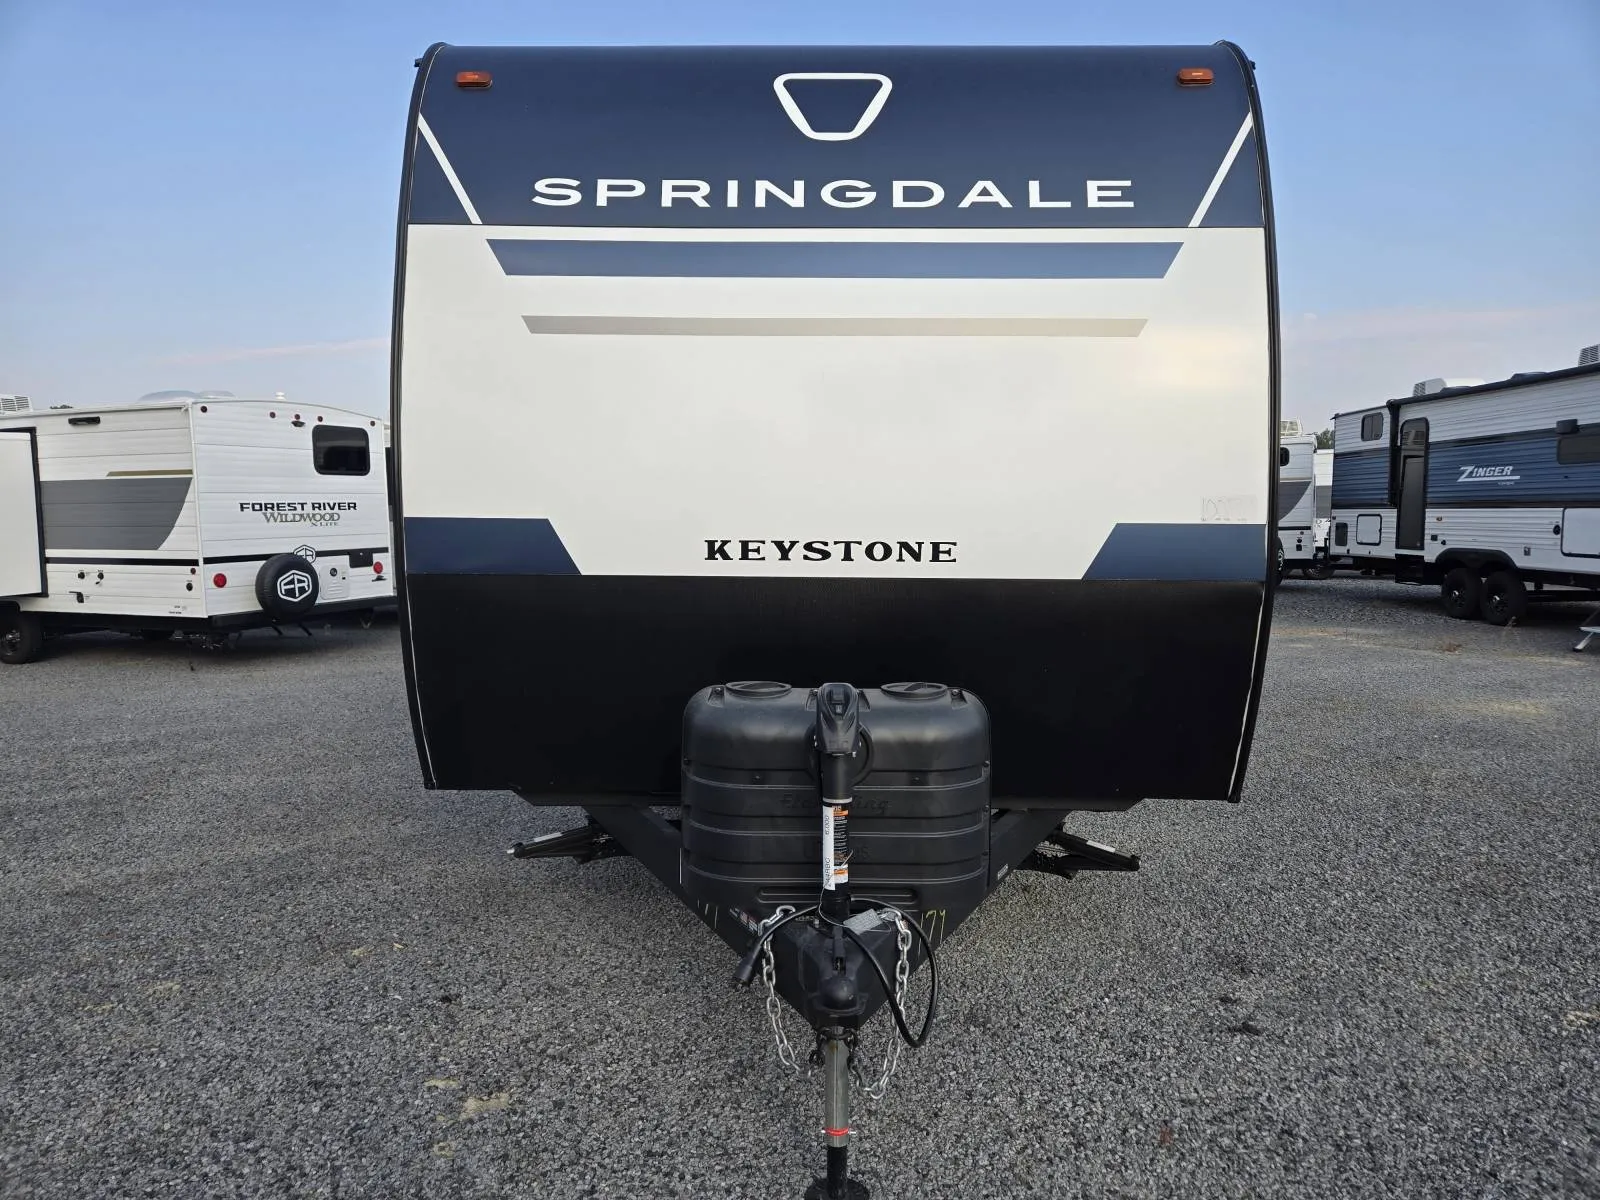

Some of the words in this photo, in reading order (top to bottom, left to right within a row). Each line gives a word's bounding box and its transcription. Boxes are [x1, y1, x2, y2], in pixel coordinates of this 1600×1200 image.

[532, 178, 1135, 209] SPRINGDALE
[1456, 465, 1521, 482] ZINGER
[239, 502, 307, 512] FOREST
[311, 502, 357, 511] RIVER
[262, 512, 341, 523] WILDWOOD
[704, 539, 957, 563] KEYSTONE
